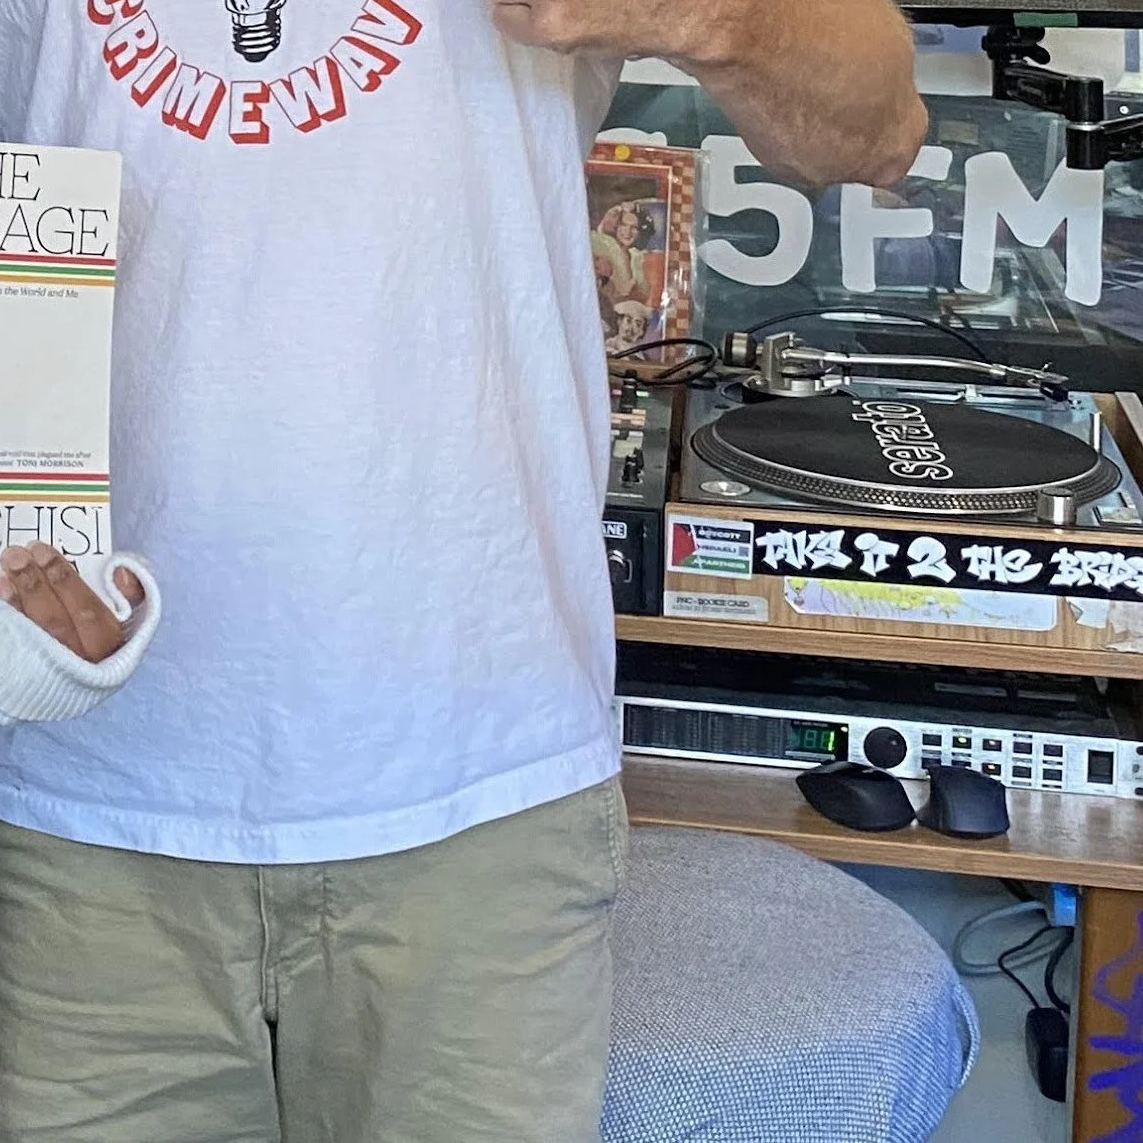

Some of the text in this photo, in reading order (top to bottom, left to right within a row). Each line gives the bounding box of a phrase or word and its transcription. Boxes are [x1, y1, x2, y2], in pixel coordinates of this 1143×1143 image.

[4, 286, 18, 295] the
[852, 401, 954, 480] serato
[907, 536, 957, 585] 2
